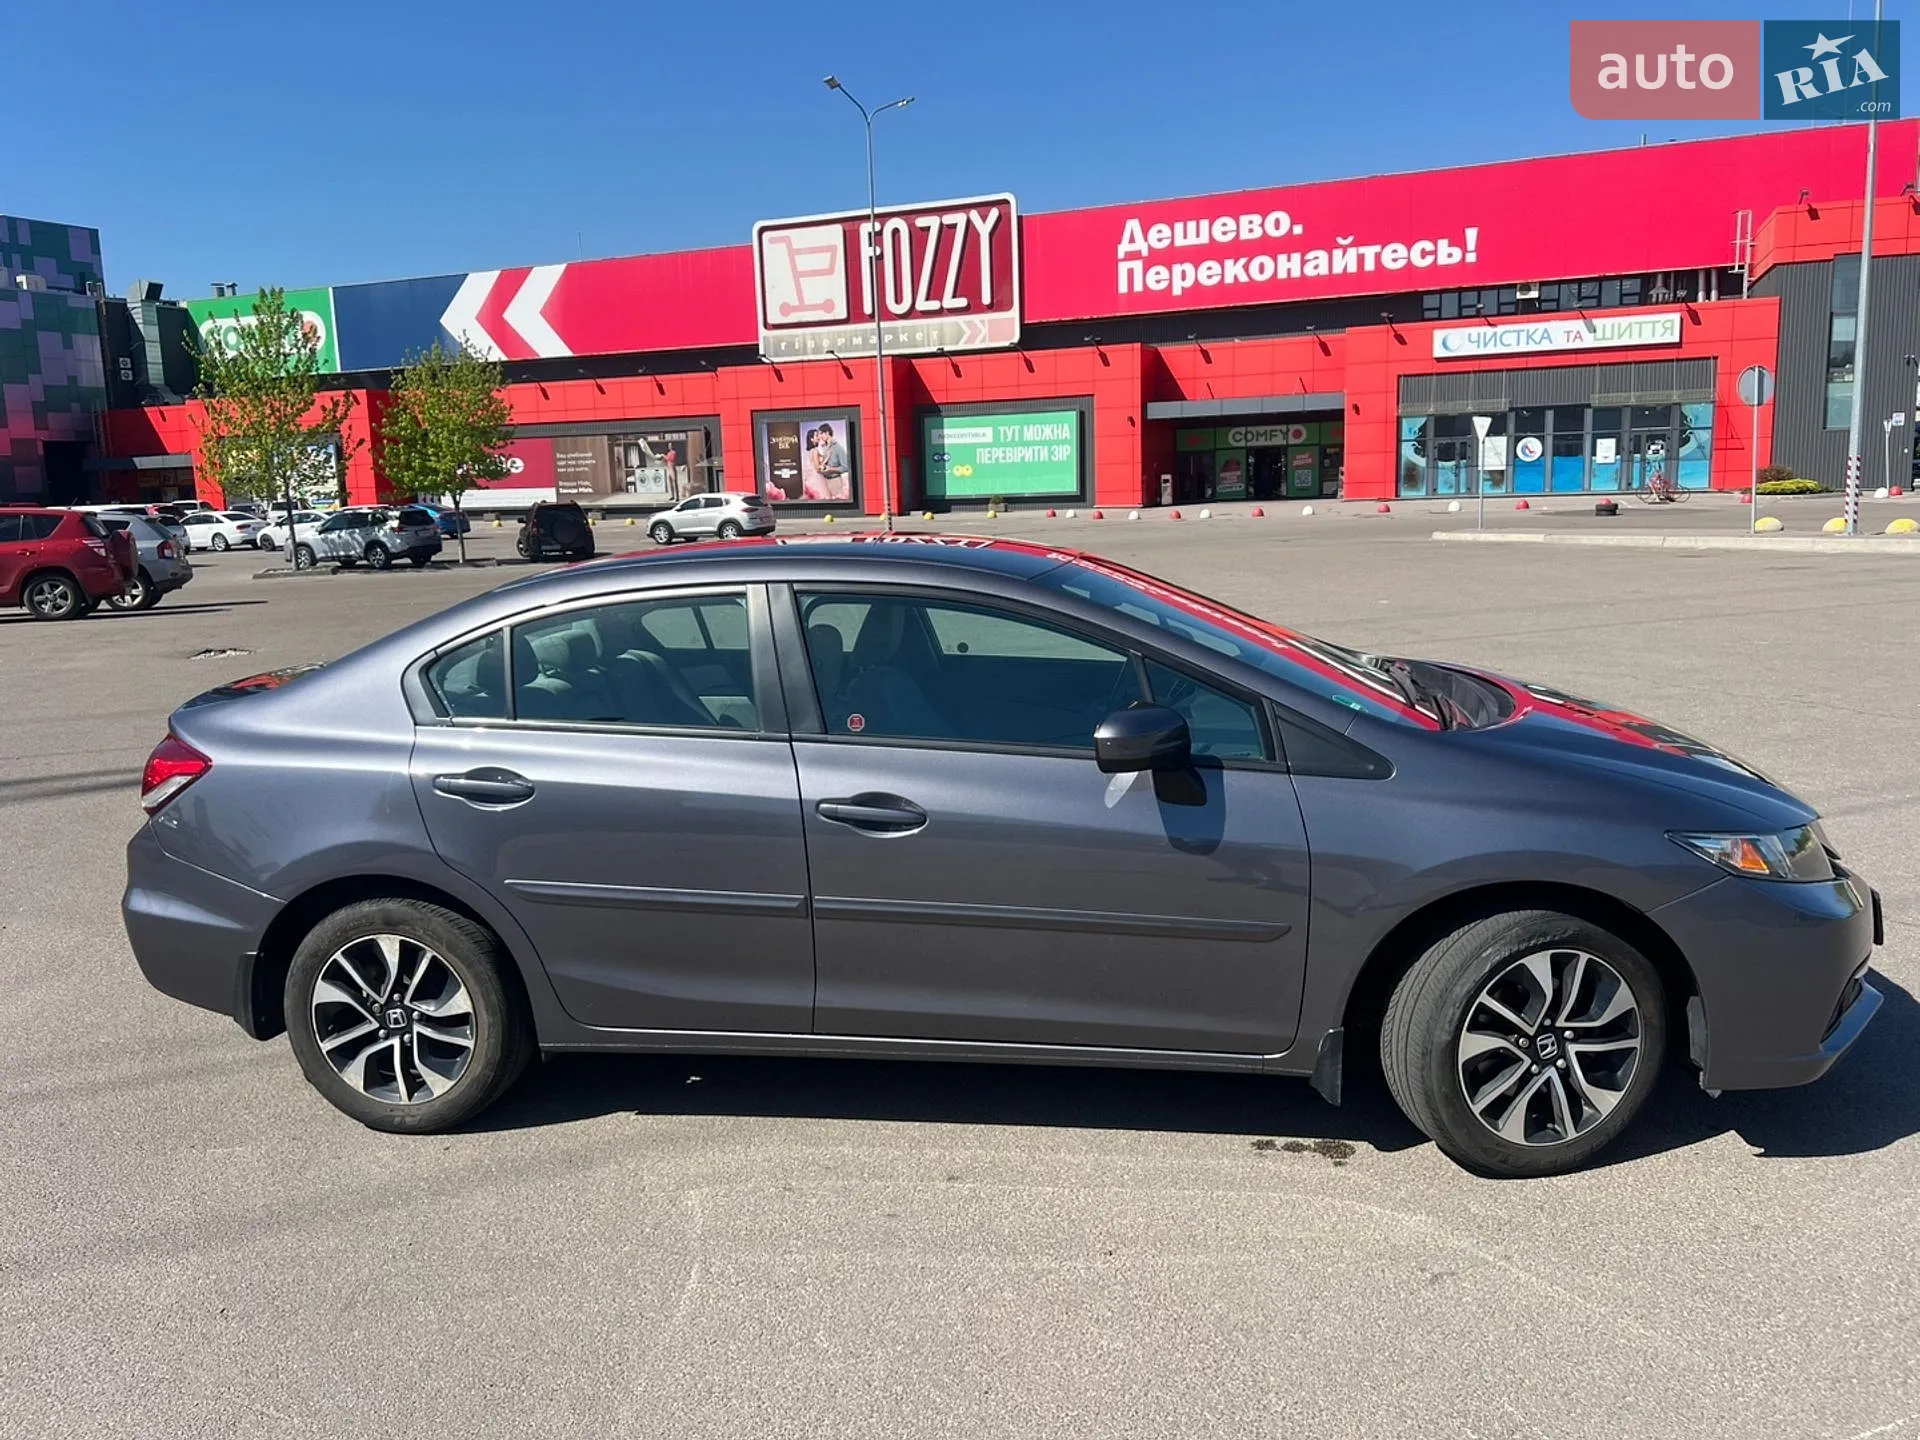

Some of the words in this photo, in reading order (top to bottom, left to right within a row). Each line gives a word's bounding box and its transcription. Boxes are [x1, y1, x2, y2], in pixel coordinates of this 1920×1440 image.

[1117, 210, 1304, 259] Дешево.
[859, 207, 1000, 315] FOZZY
[1117, 226, 1479, 296] Переконайтесь!
[1468, 328, 1553, 350] ЧИСТКА
[1564, 329, 1584, 343] ТА
[1593, 319, 1676, 342] ШИТТЯ
[998, 425, 1021, 442] ТУТ
[1023, 423, 1071, 441] МОЖНА
[1232, 429, 1289, 443] COMFY
[976, 446, 1049, 464] ПЕРЕВІРИТИ
[1051, 445, 1071, 461] ЗІР
